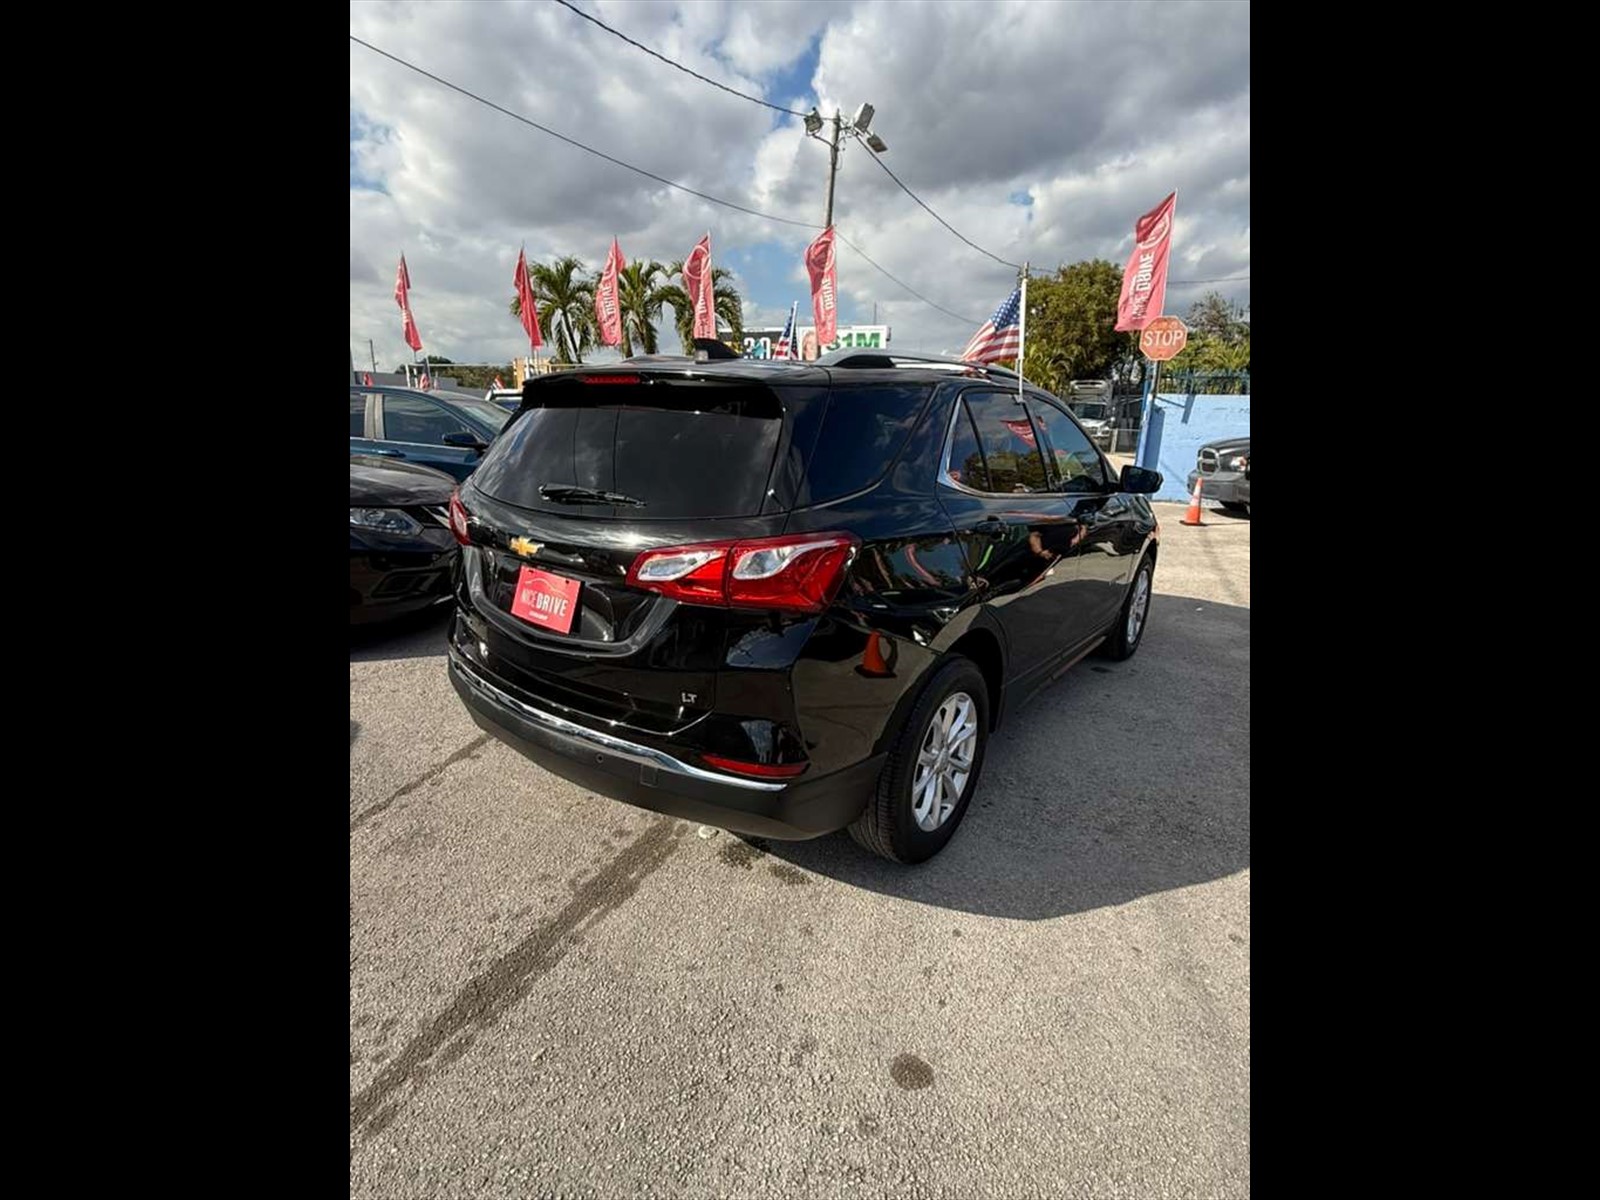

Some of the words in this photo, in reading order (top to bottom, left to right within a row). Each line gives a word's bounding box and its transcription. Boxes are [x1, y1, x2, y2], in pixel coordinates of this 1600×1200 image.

[1136, 251, 1155, 292] DRIVE
[601, 282, 616, 315] DRIVE
[821, 277, 834, 311] DRIVE
[1144, 329, 1184, 347] STOP
[536, 592, 569, 617] DRIVE
[681, 692, 698, 704] LT
